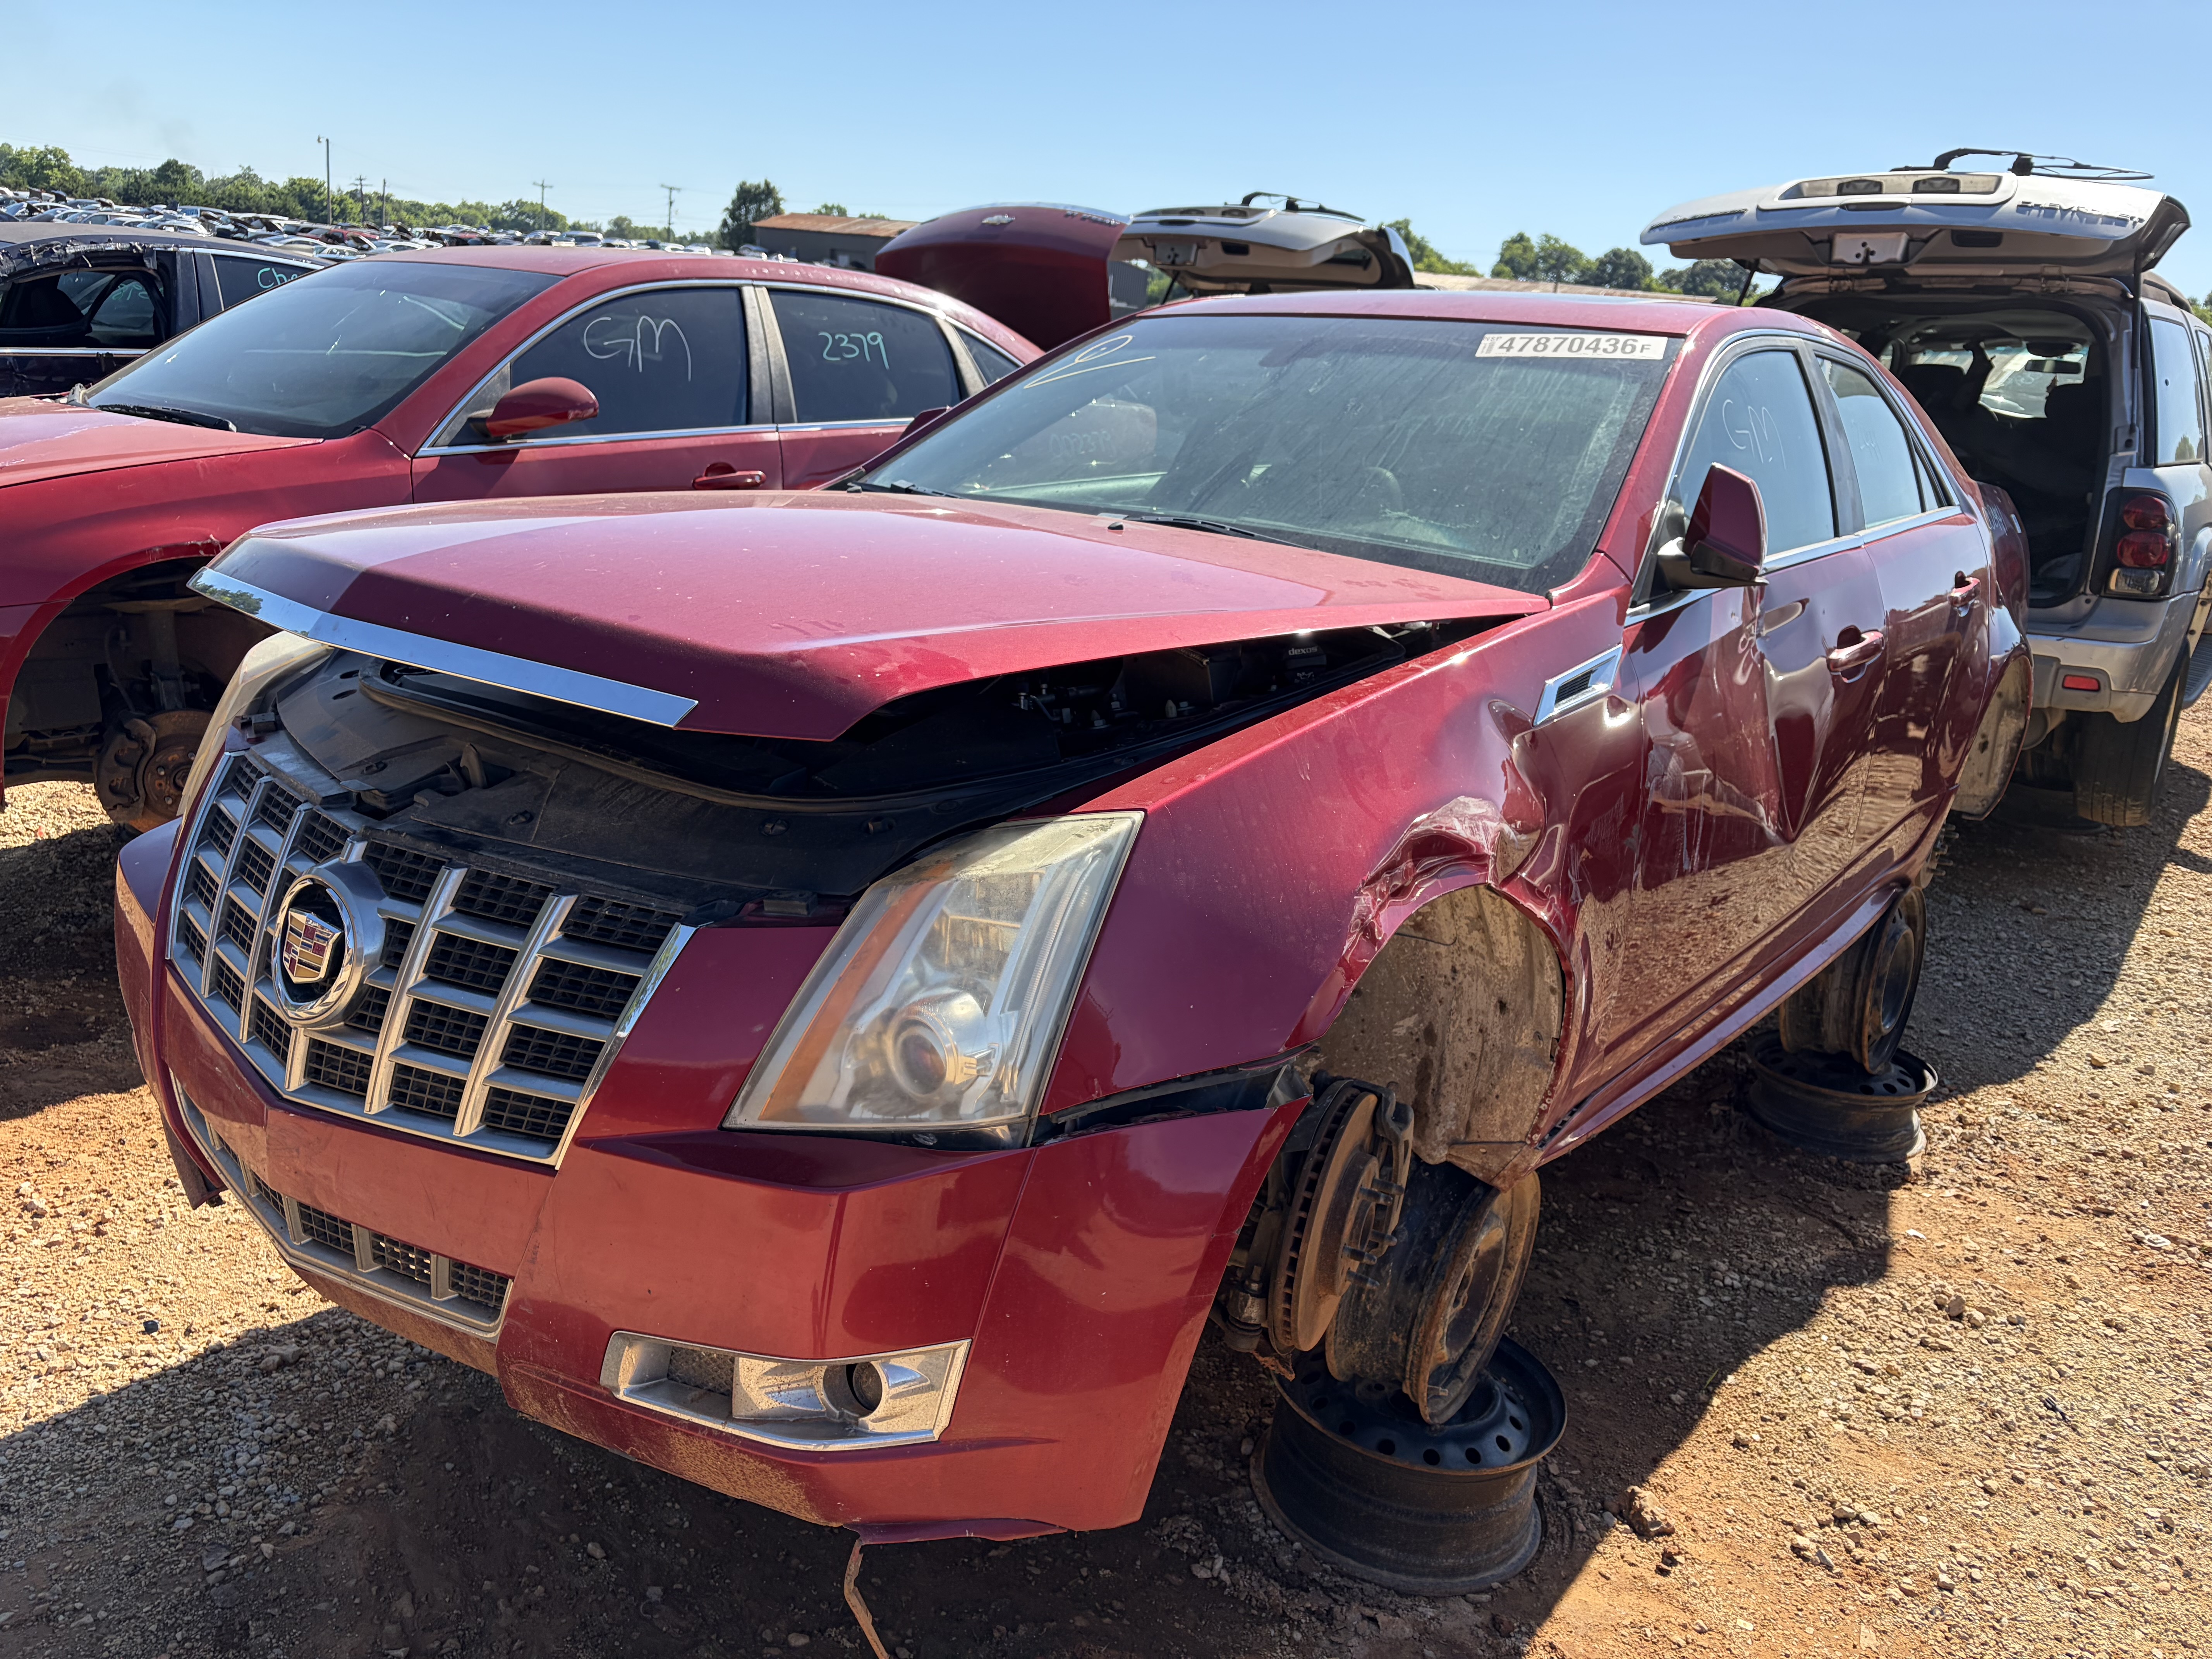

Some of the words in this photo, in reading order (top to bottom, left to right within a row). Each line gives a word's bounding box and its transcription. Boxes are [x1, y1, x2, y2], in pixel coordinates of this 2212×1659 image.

[583, 315, 691, 382] GM
[818, 331, 890, 370] 2379
[1723, 399, 1786, 469] GM
[1289, 647, 1317, 655] dexos
